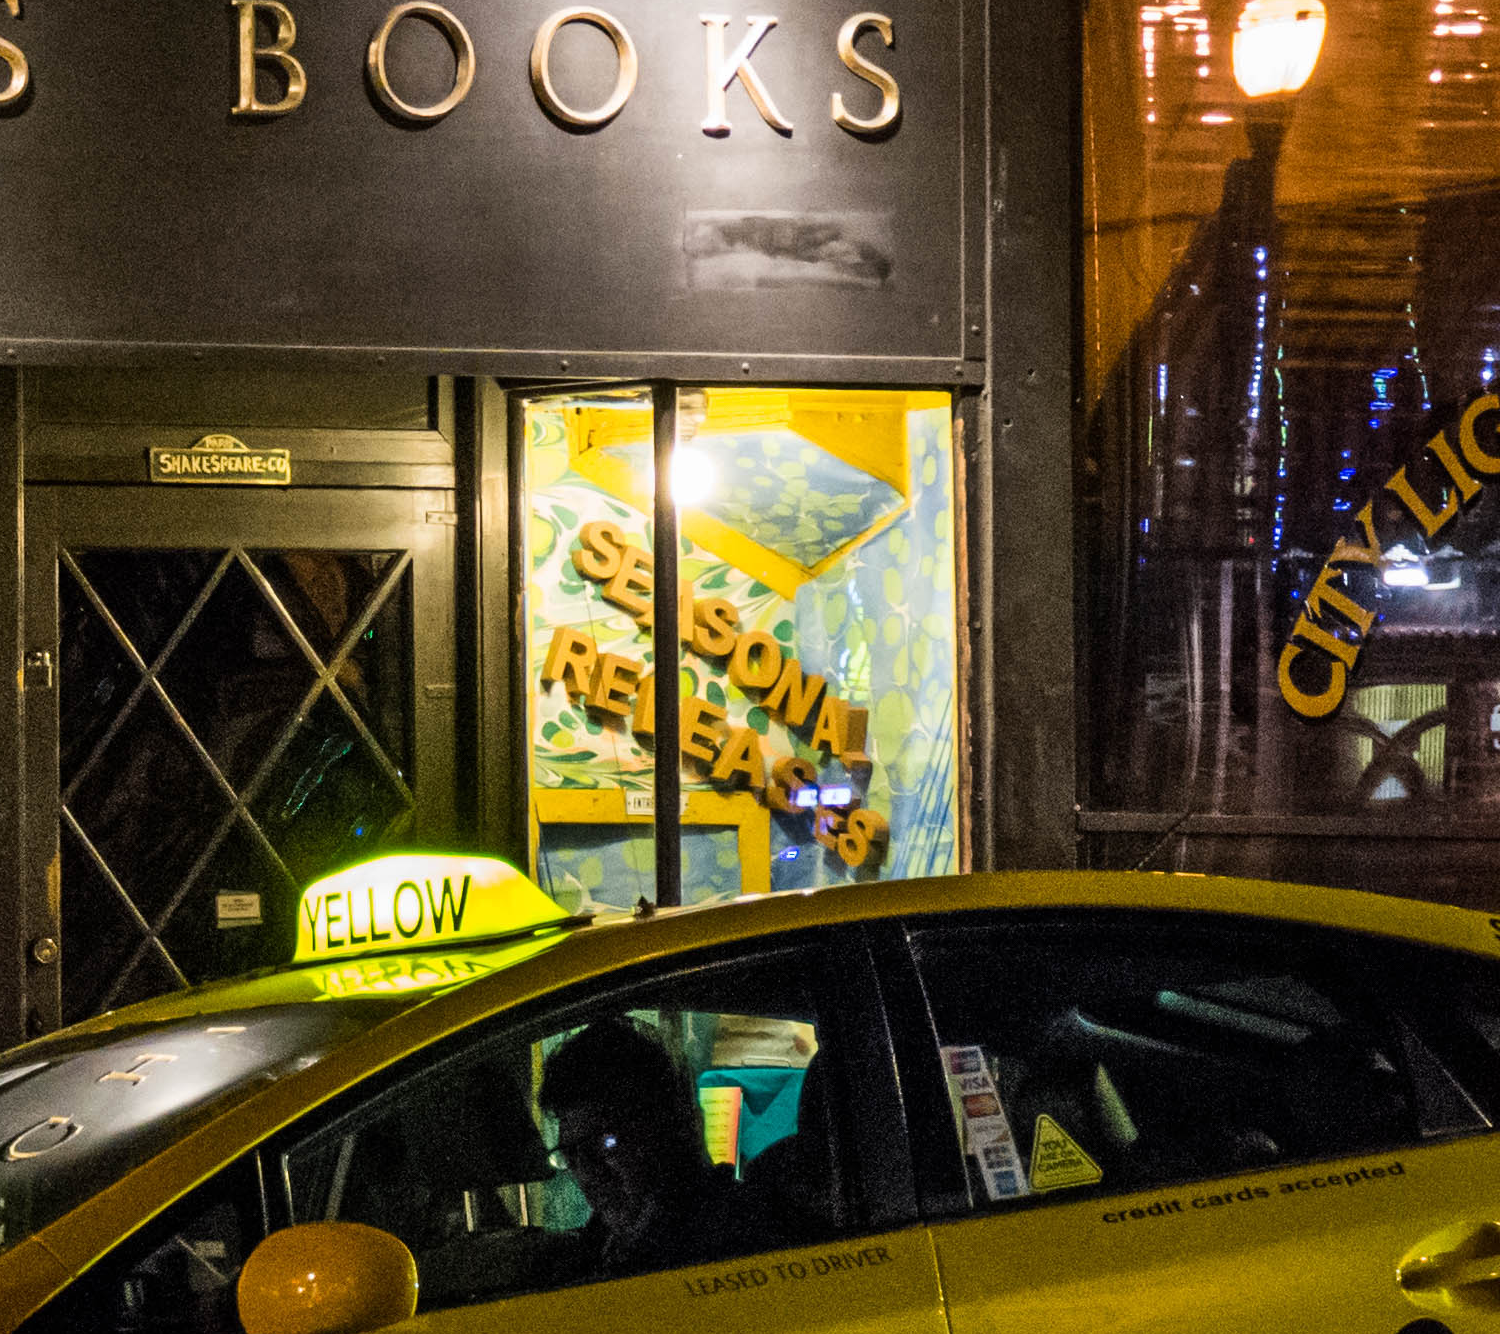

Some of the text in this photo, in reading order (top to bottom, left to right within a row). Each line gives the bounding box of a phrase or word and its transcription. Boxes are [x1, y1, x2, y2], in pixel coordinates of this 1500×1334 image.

[1277, 393, 1500, 719] CITY LIG
[304, 874, 472, 952] YELLOW
[1102, 1161, 1406, 1225] credit cards accepted
[683, 1246, 893, 1296] LEASED TO DRIVER
